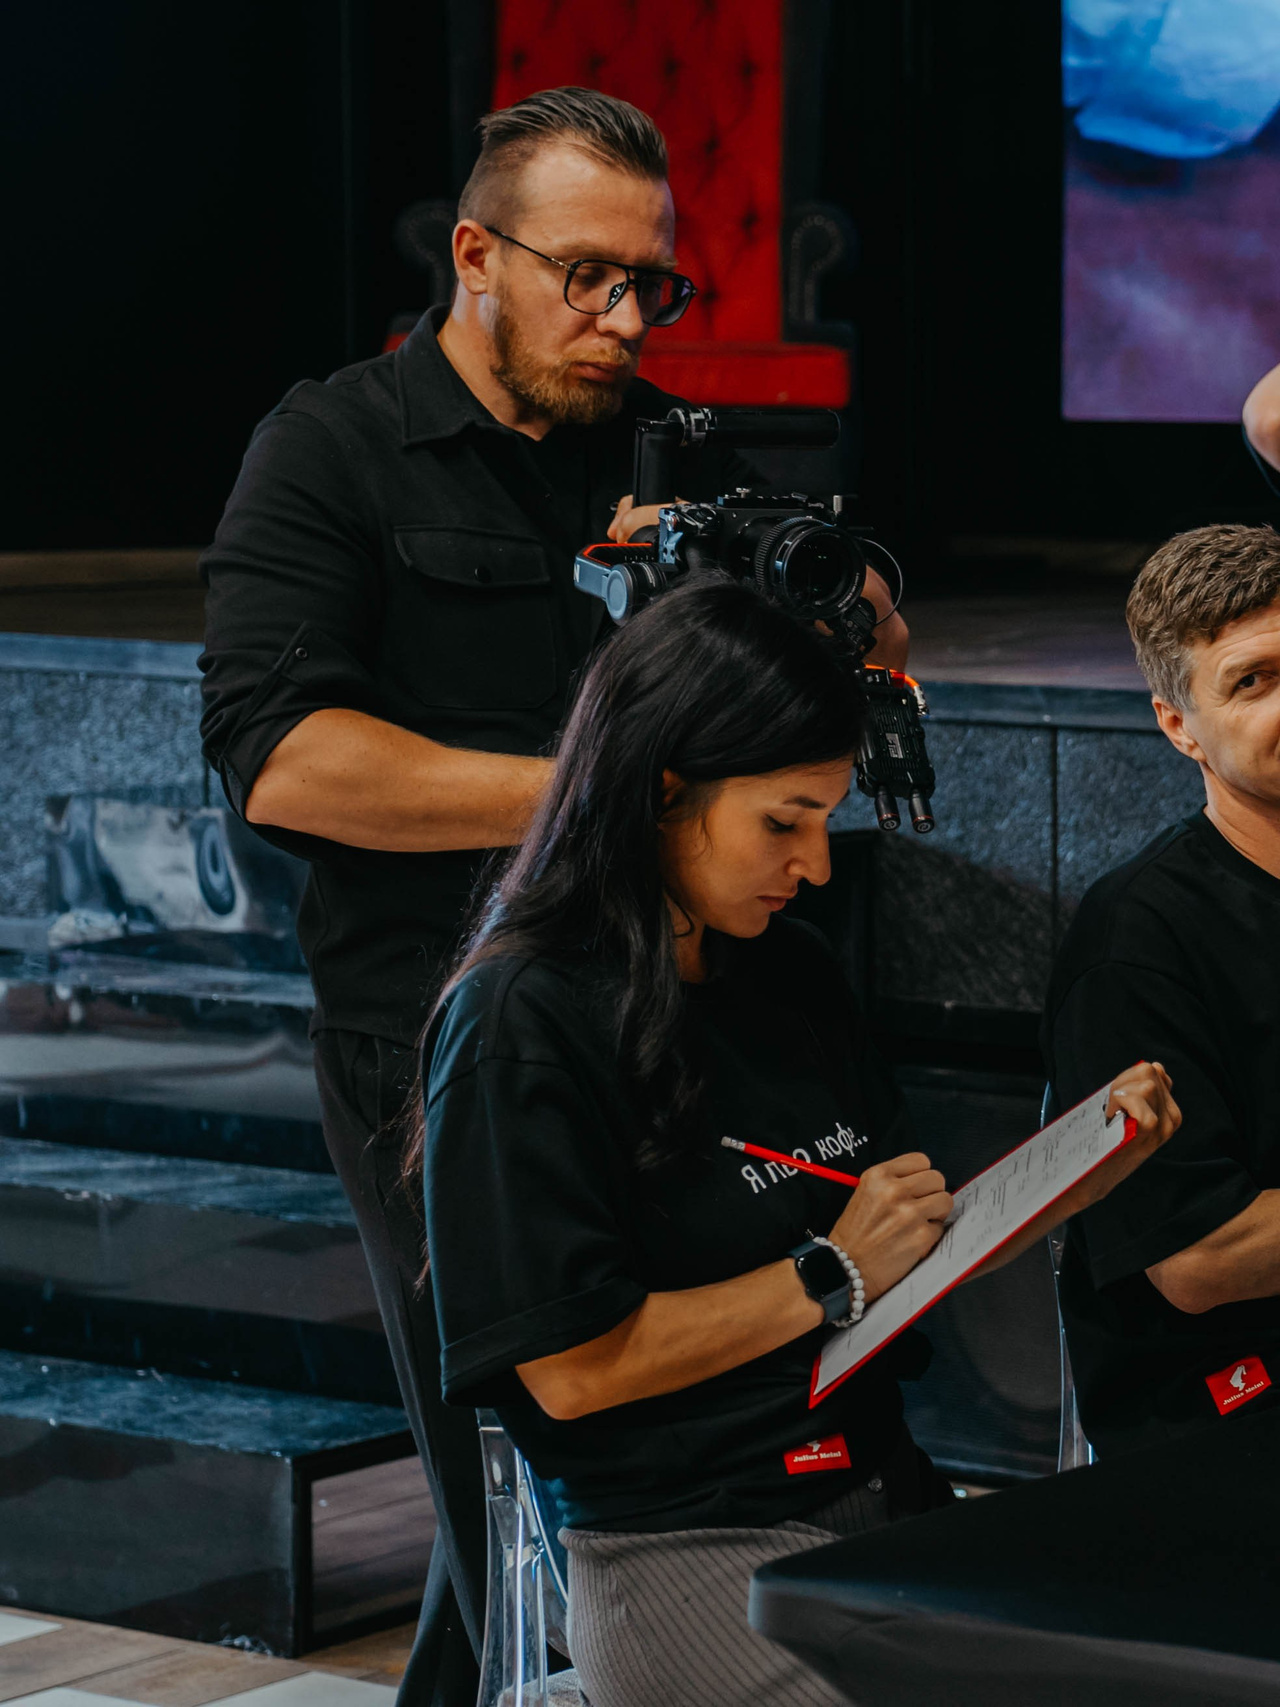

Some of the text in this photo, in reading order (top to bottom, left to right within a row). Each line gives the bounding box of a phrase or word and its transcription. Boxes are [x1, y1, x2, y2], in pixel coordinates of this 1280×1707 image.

[741, 1164, 767, 1194] Я
[764, 1148, 811, 1183] пь
[793, 1454, 818, 1463] Julius
